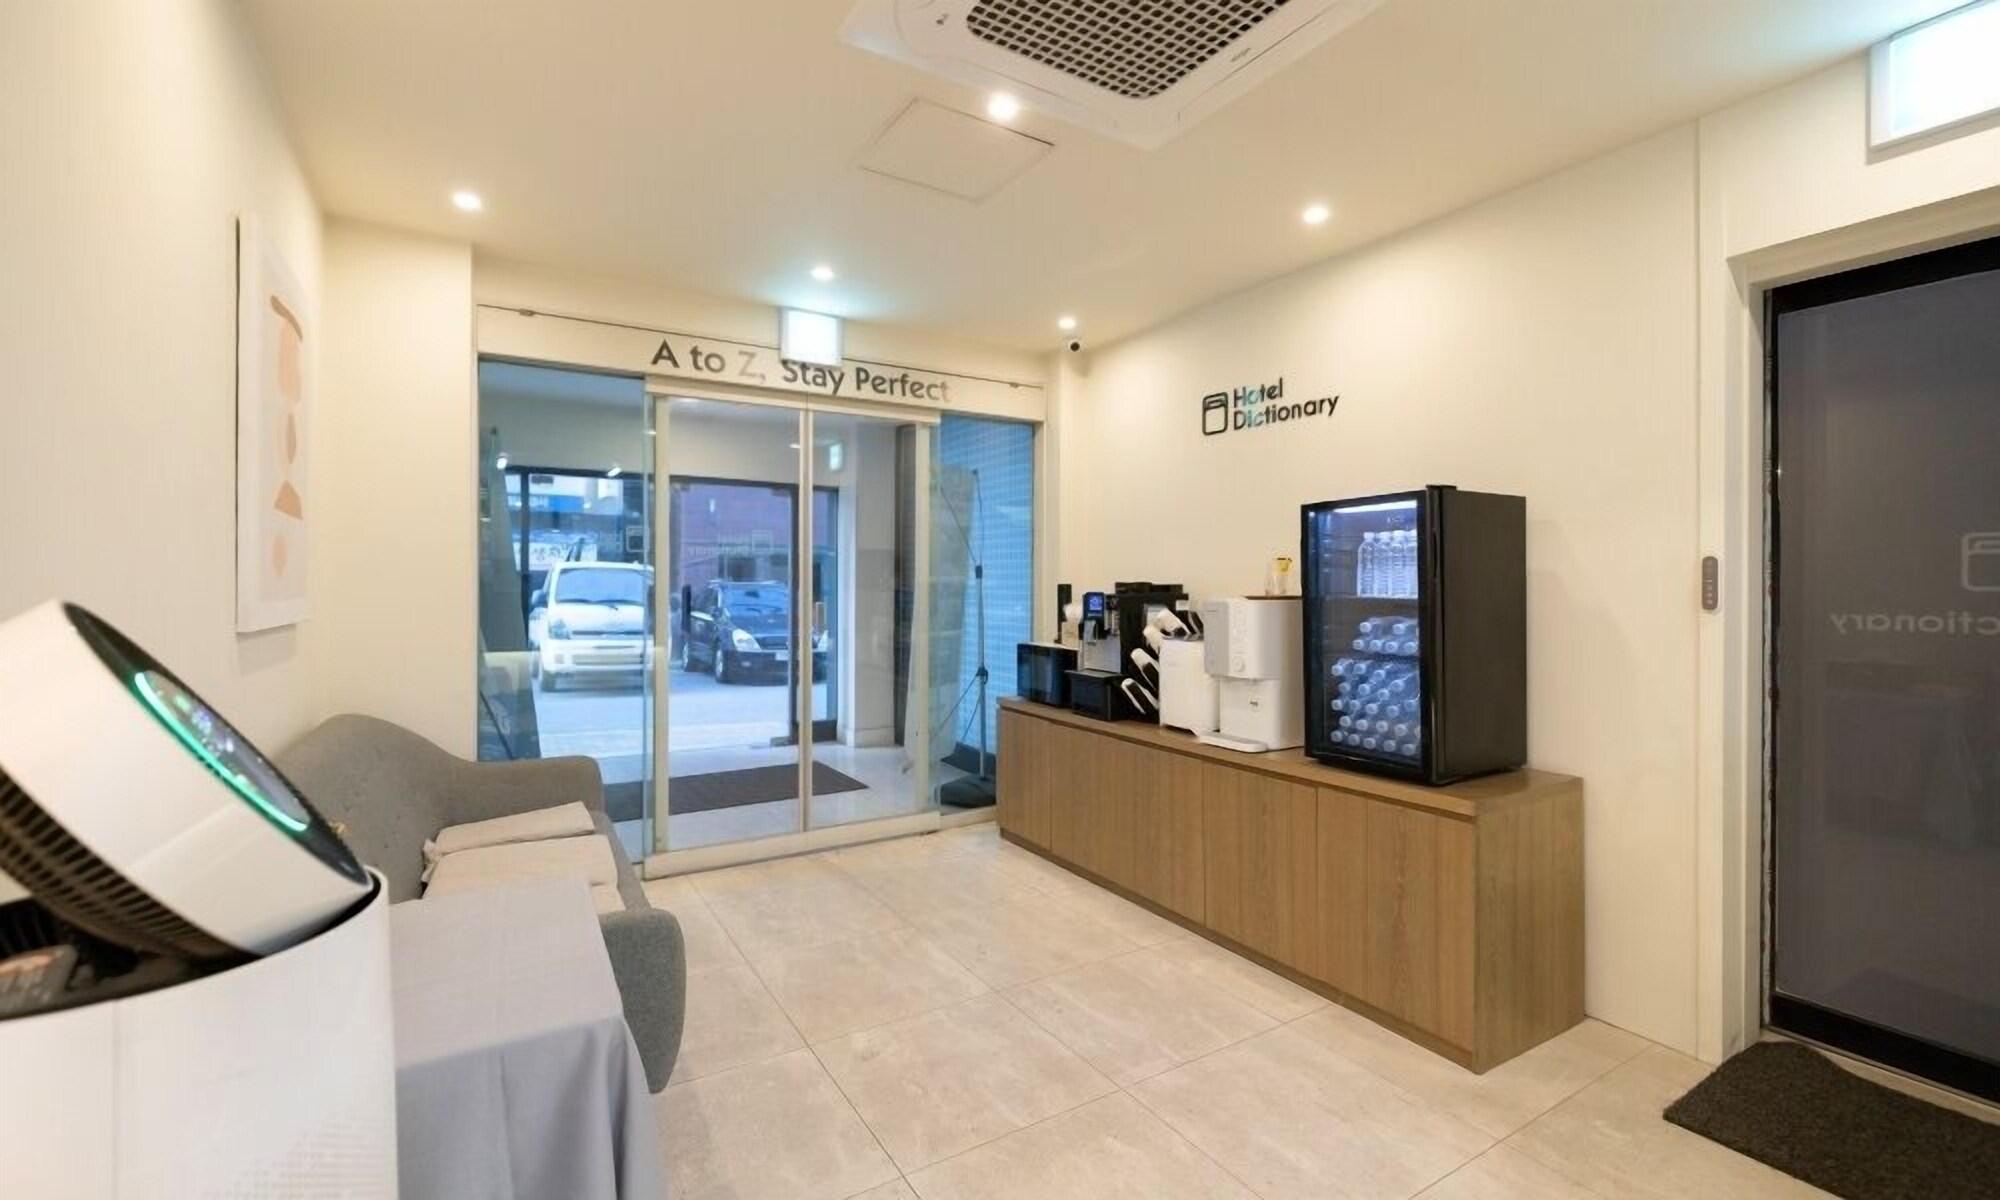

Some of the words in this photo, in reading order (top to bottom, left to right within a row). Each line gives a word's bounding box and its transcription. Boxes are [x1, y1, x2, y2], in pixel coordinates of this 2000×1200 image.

[651, 339, 680, 368] A
[689, 345, 726, 373] to
[738, 350, 766, 384] Z,
[781, 359, 845, 396] Stay
[855, 367, 951, 403] Perfect
[1233, 377, 1283, 408] Hotel
[1233, 396, 1339, 430] Dictionary
